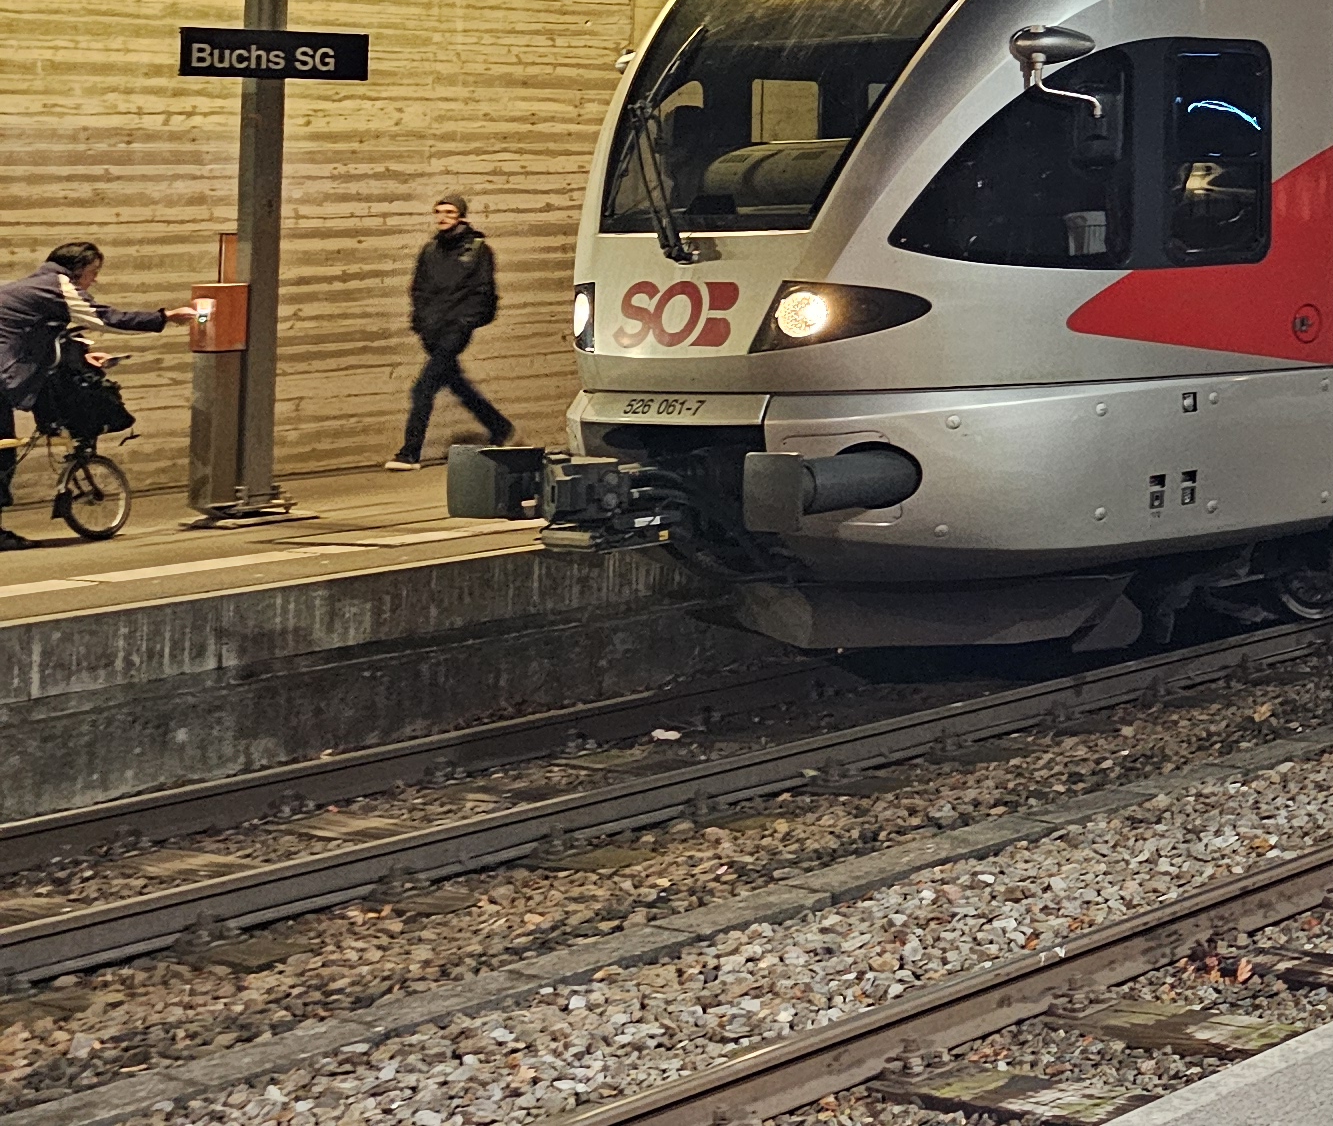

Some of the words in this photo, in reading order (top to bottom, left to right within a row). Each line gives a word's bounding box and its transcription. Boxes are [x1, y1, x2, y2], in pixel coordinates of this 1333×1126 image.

[190, 43, 286, 70] Buchs
[294, 47, 336, 71] SG
[612, 280, 740, 348] SOB
[623, 398, 655, 415] 526
[657, 398, 707, 416] 061-7
